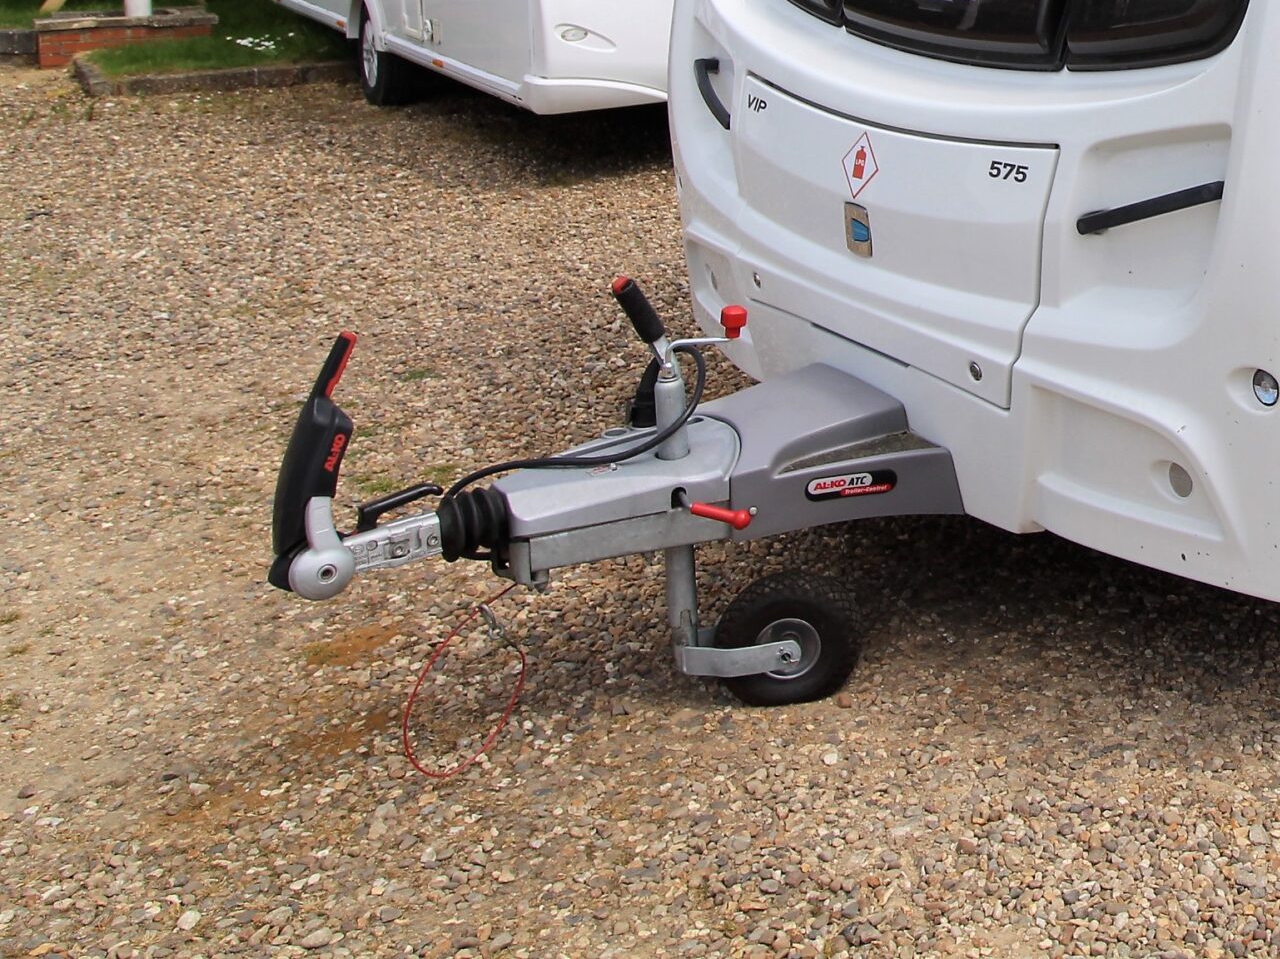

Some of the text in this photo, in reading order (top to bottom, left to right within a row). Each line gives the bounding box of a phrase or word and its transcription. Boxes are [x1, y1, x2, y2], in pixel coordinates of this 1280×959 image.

[747, 94, 767, 114] VIP
[855, 158, 865, 167] LPG
[988, 160, 1029, 183] 575
[814, 476, 868, 492] AL-KO ATC
